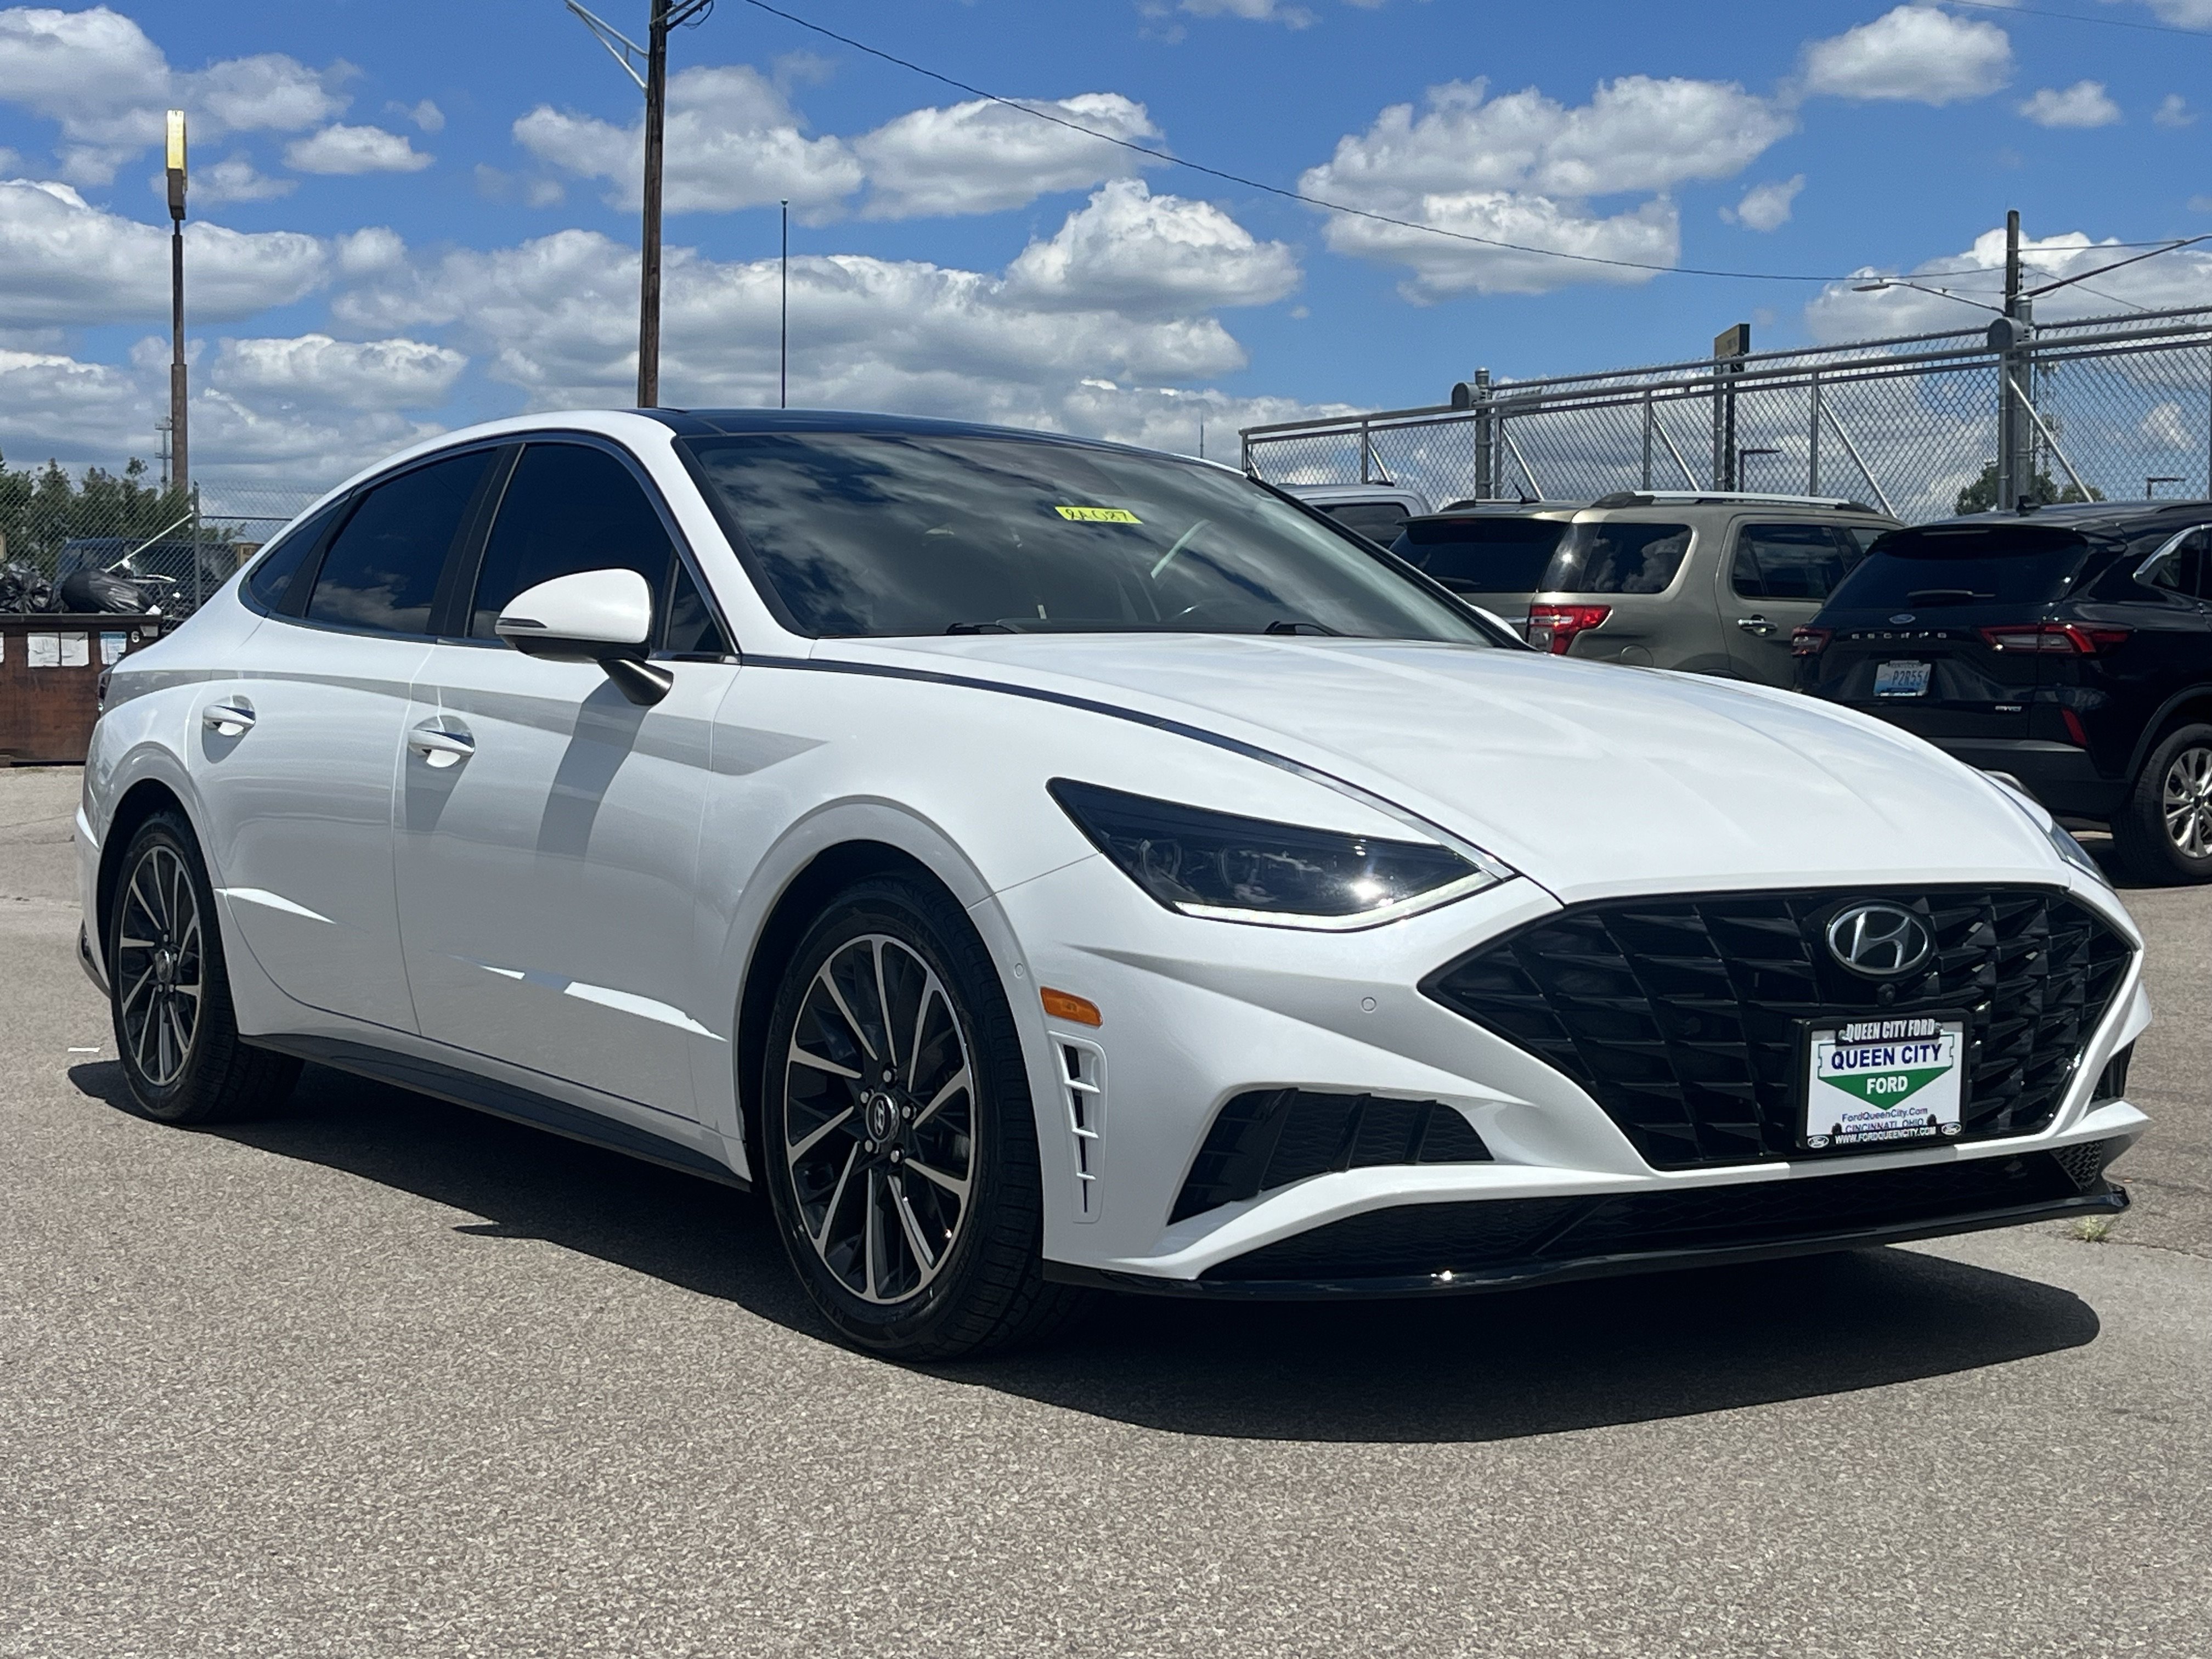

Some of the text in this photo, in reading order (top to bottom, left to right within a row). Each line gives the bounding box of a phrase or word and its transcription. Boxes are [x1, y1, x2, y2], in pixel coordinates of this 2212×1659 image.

[131, 630, 139, 643] 6
[1846, 1019, 1936, 1042] QUEEN CITY FORD
[1832, 1043, 1942, 1070] QUEEN CITY
[1866, 1075, 1908, 1095] FORD
